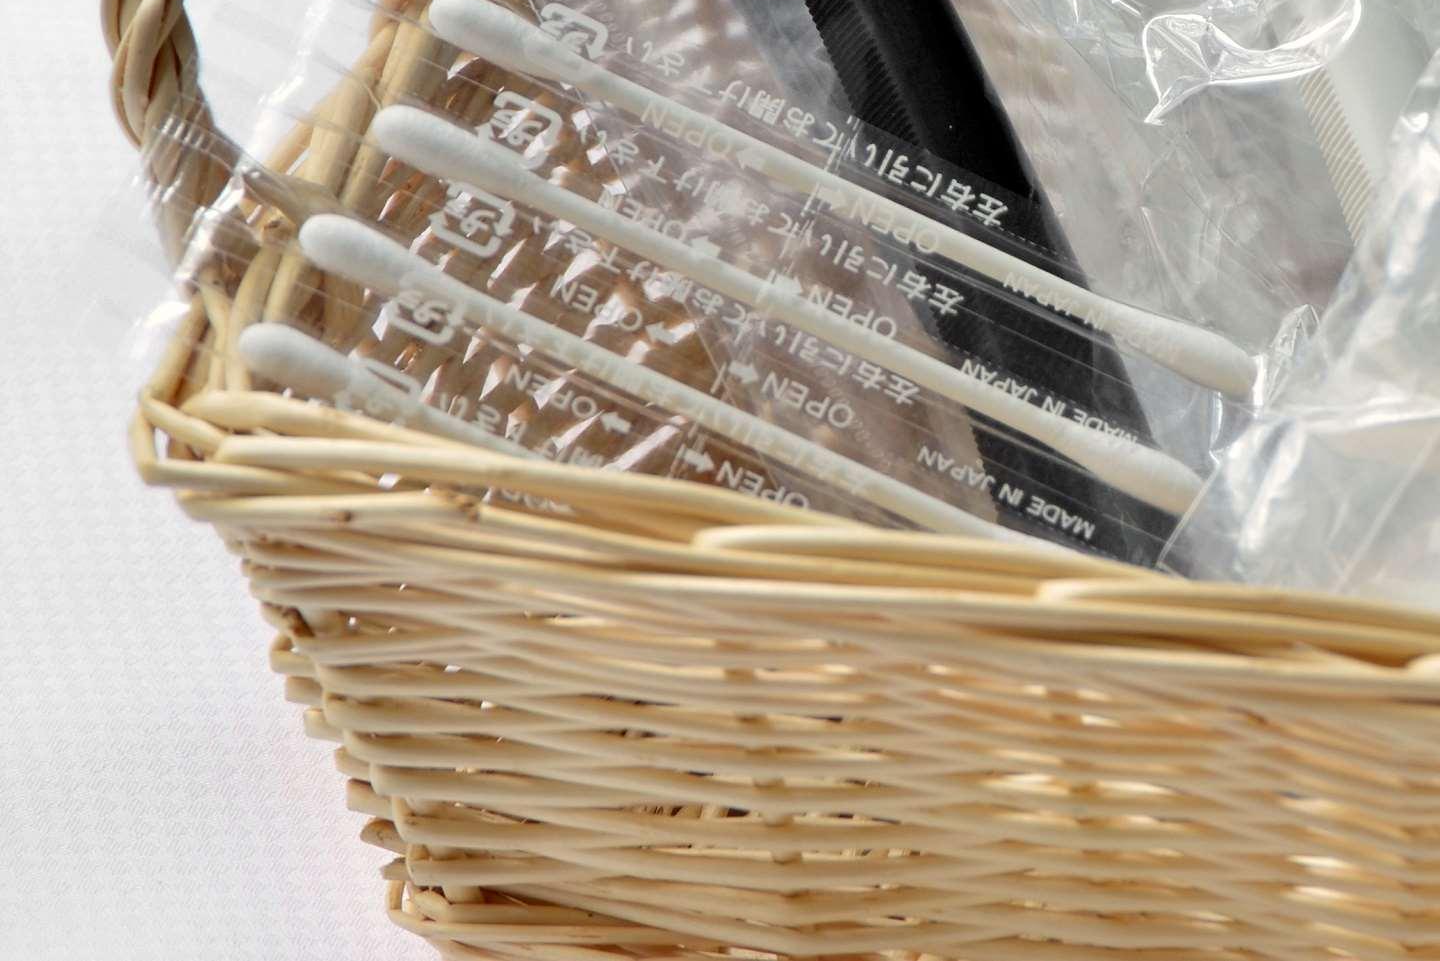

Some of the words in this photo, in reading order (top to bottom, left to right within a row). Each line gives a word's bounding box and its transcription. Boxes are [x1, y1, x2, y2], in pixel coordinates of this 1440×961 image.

[639, 99, 734, 159] OPEN
[596, 186, 689, 245] OPEN
[847, 195, 942, 256] OPEN
[806, 283, 899, 341] OPEN
[502, 362, 598, 422] OPEN
[760, 369, 856, 430] OPEN
[959, 357, 1038, 405] JAPAN
[1040, 395, 1065, 418] IN
[715, 458, 810, 519] OPEN
[915, 444, 996, 493] JAPAN
[997, 482, 1023, 505] IN
[1025, 495, 1095, 539] MADE
